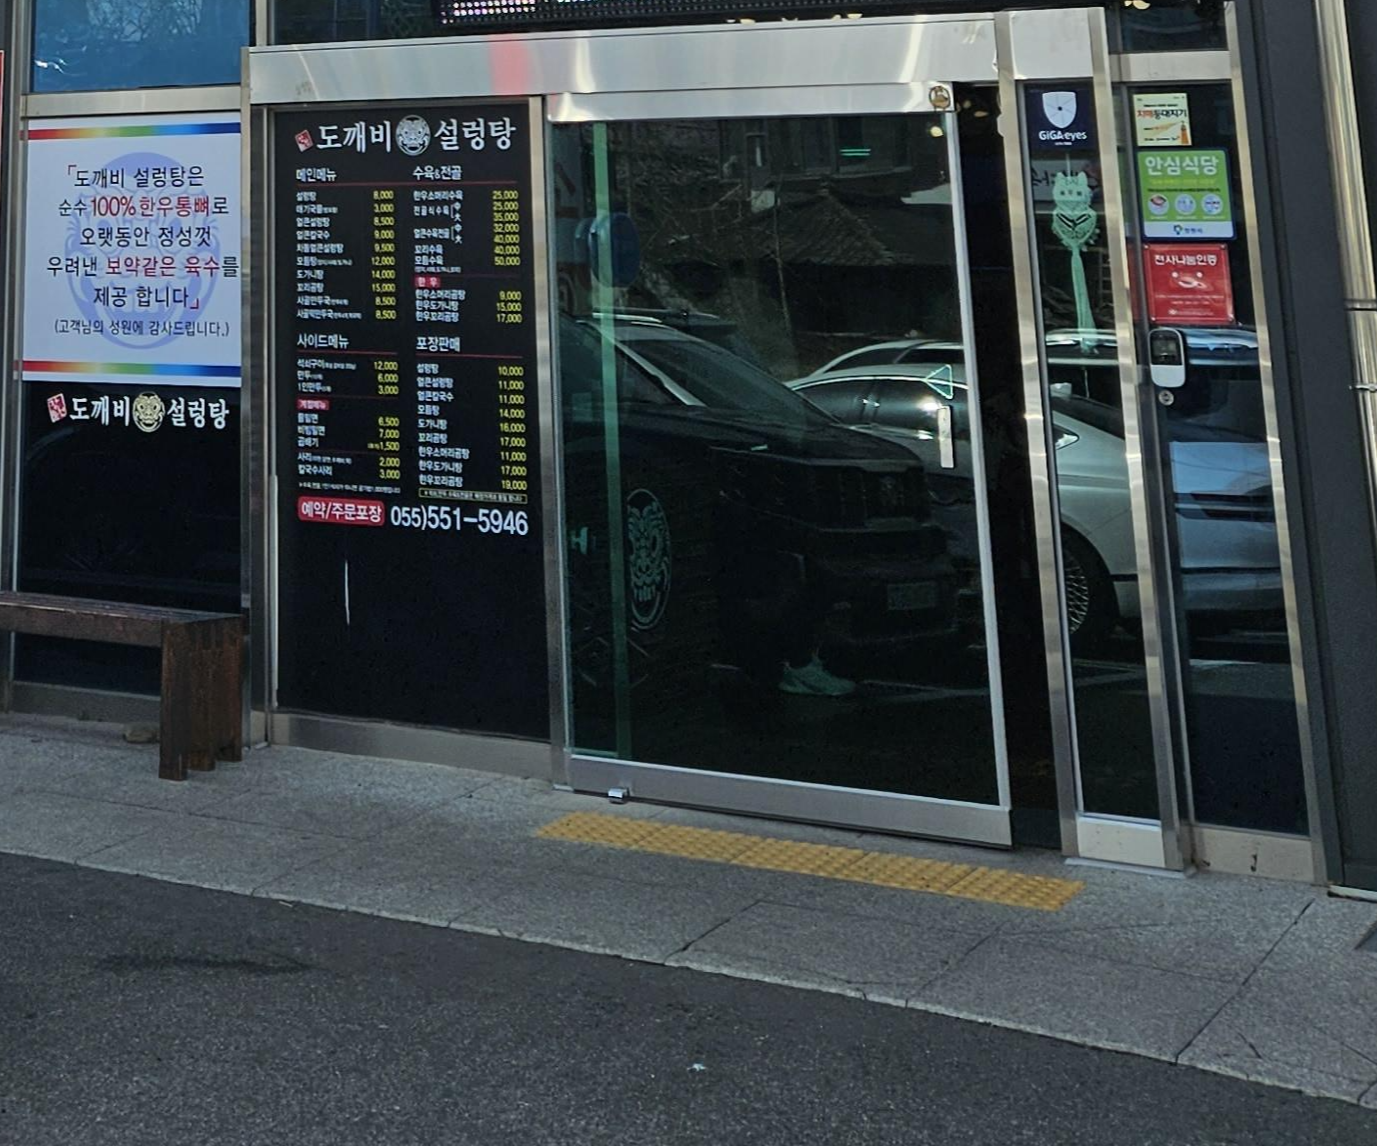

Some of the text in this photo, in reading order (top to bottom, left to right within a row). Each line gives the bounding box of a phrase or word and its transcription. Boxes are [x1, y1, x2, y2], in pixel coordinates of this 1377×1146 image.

[316, 120, 392, 153] 도깨비
[434, 117, 517, 151] 설렁탕
[1144, 155, 1220, 176] 안심식당
[133, 165, 205, 189] 설렁탕은
[296, 167, 337, 183] 메인메뉴
[58, 194, 230, 218] 순수 100% 한우통뼈로
[79, 225, 212, 248] 오랫동안 정성껏
[46, 255, 240, 278] 우려낸 보약같은 육수를
[93, 285, 128, 308] 제공
[496, 313, 523, 323] 17,000
[54, 318, 104, 335] (고객님의
[108, 320, 144, 337] 성원에
[296, 333, 349, 349] 사이드메뉴
[416, 336, 461, 352] 포장판매
[497, 366, 524, 376] 10,000
[498, 380, 525, 390] 11,000
[499, 394, 525, 405] 11,000
[69, 395, 130, 427] 도깨비
[166, 396, 231, 430] 설렁탕
[500, 437, 527, 447] 17,000
[379, 457, 401, 467] 2,000
[500, 451, 527, 462] 11,000
[500, 466, 528, 476] 17,000
[300, 500, 529, 536] 예약/주문포장 055)551-5946
